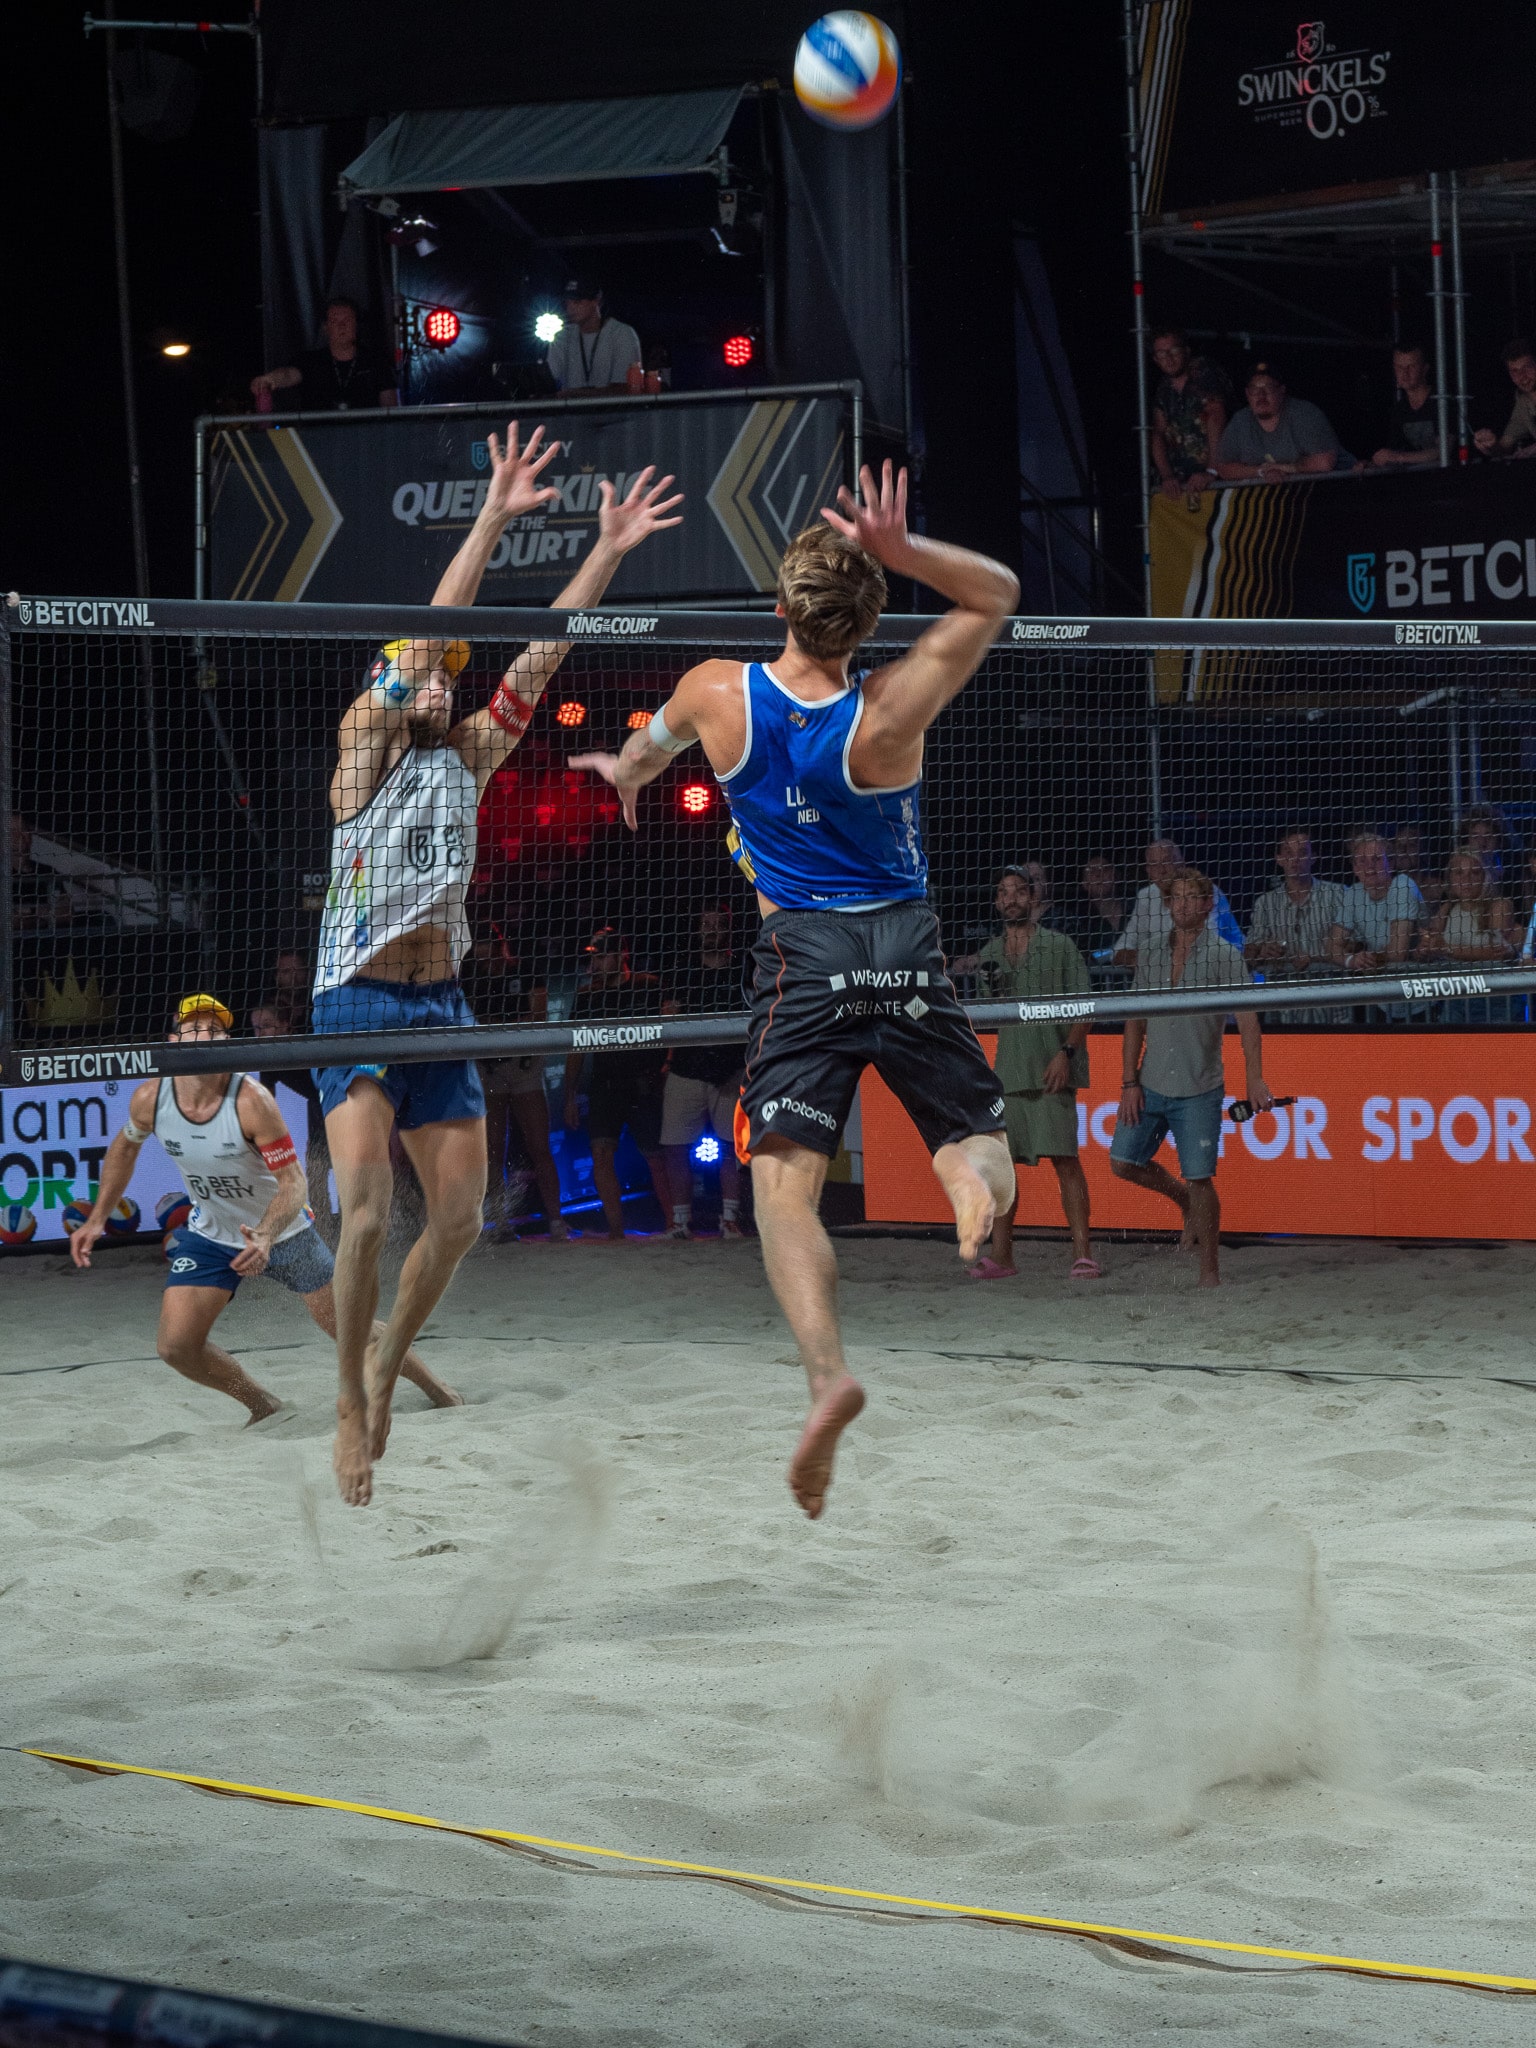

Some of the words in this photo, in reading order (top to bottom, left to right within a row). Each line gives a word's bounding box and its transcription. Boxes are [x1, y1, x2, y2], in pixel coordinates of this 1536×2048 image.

[1238, 51, 1391, 106] SWINCKELS'
[392, 479, 491, 526] QUEE
[519, 515, 547, 531] THE
[487, 529, 588, 569] OURT
[35, 601, 155, 627] BETCITY.NL
[566, 615, 604, 634] KING
[610, 617, 658, 635] COURT
[1012, 623, 1049, 640] QUEEN
[1053, 625, 1090, 640] COURT
[1405, 624, 1482, 644] BETCITY.NL
[797, 807, 820, 825] NED
[1411, 975, 1491, 998] BETCITY.NL
[1019, 1003, 1056, 1021] QUEEN
[1060, 1002, 1096, 1018] COURT
[572, 1027, 609, 1047] KING
[615, 1025, 663, 1045] COURT
[38, 1050, 159, 1081] BETCITY.NL
[1216, 1096, 1333, 1161] FOR
[207, 1175, 241, 1188] BET
[215, 1184, 255, 1199] CITY
